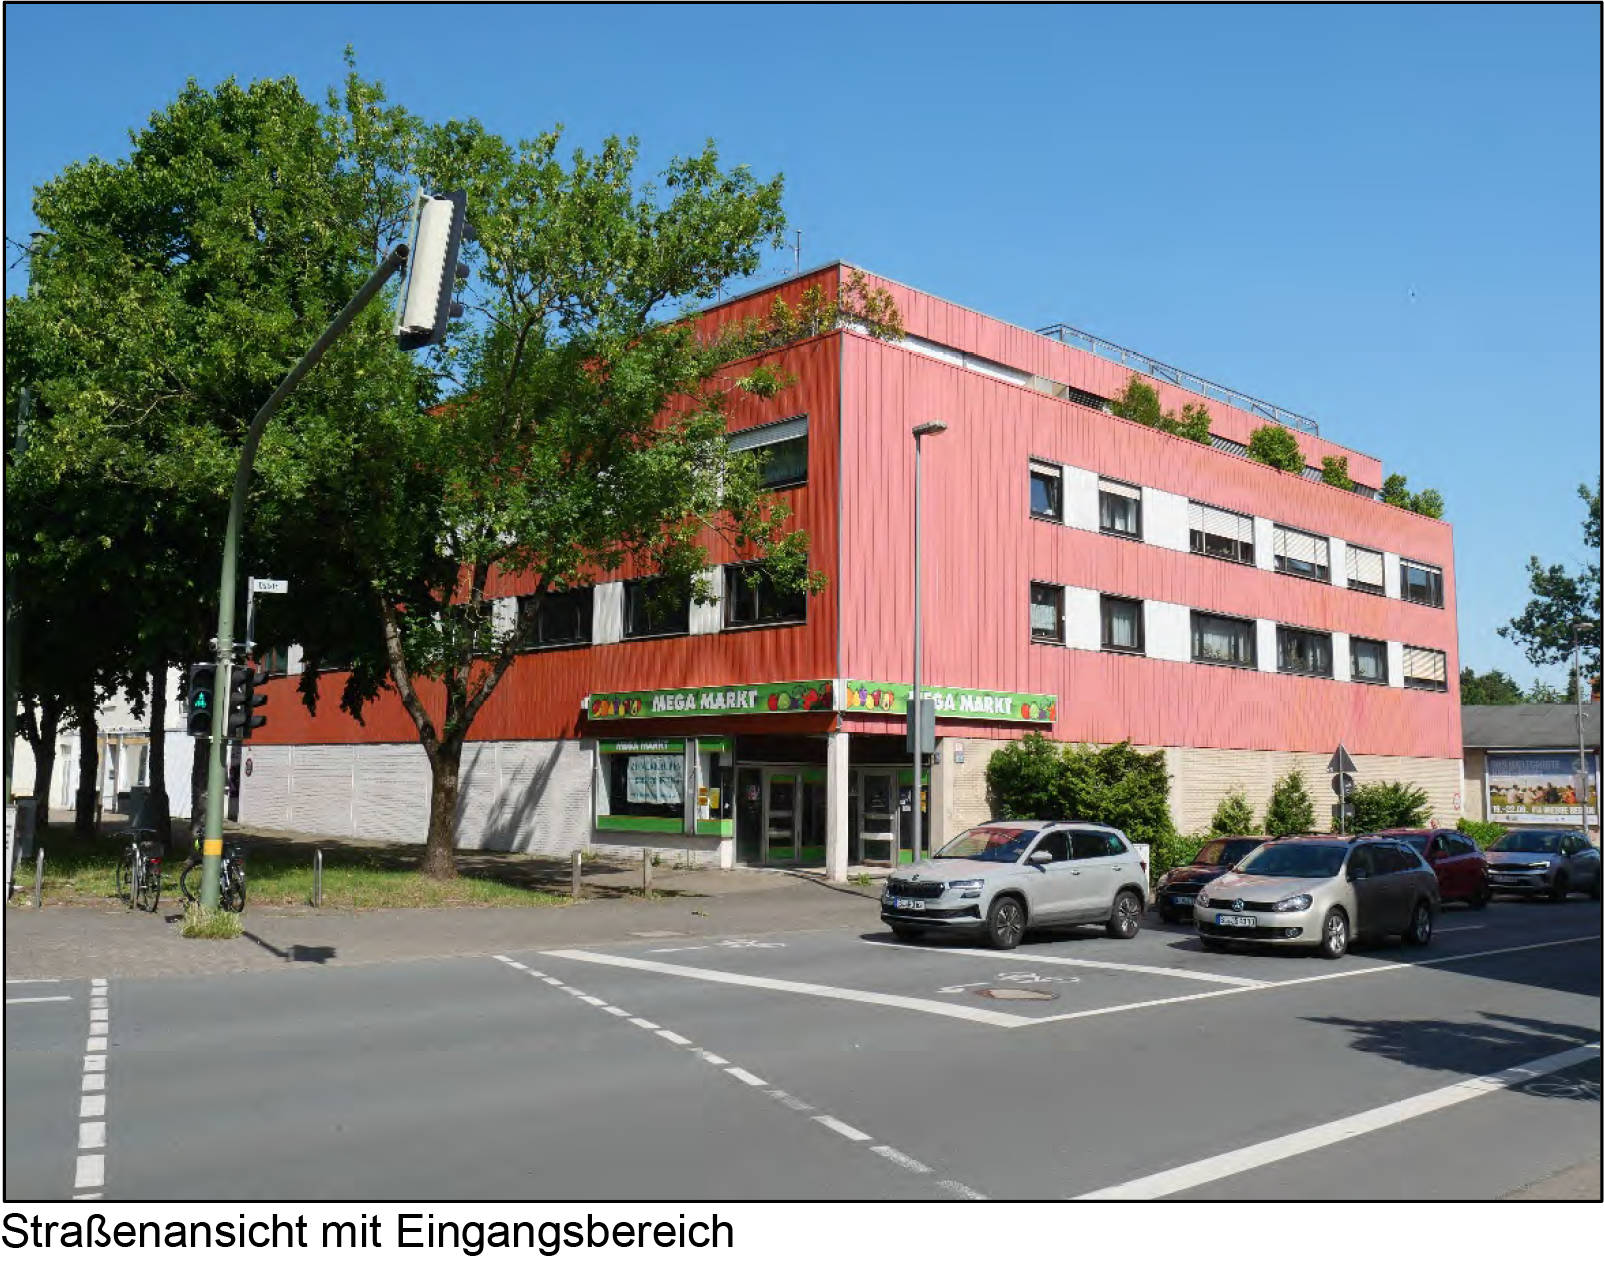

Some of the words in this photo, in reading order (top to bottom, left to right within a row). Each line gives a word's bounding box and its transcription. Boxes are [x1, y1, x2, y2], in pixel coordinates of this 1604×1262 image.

[652, 692, 697, 712] MEGA
[700, 690, 758, 710] MARKT
[908, 690, 956, 712] GA
[959, 694, 1014, 715] MARKT
